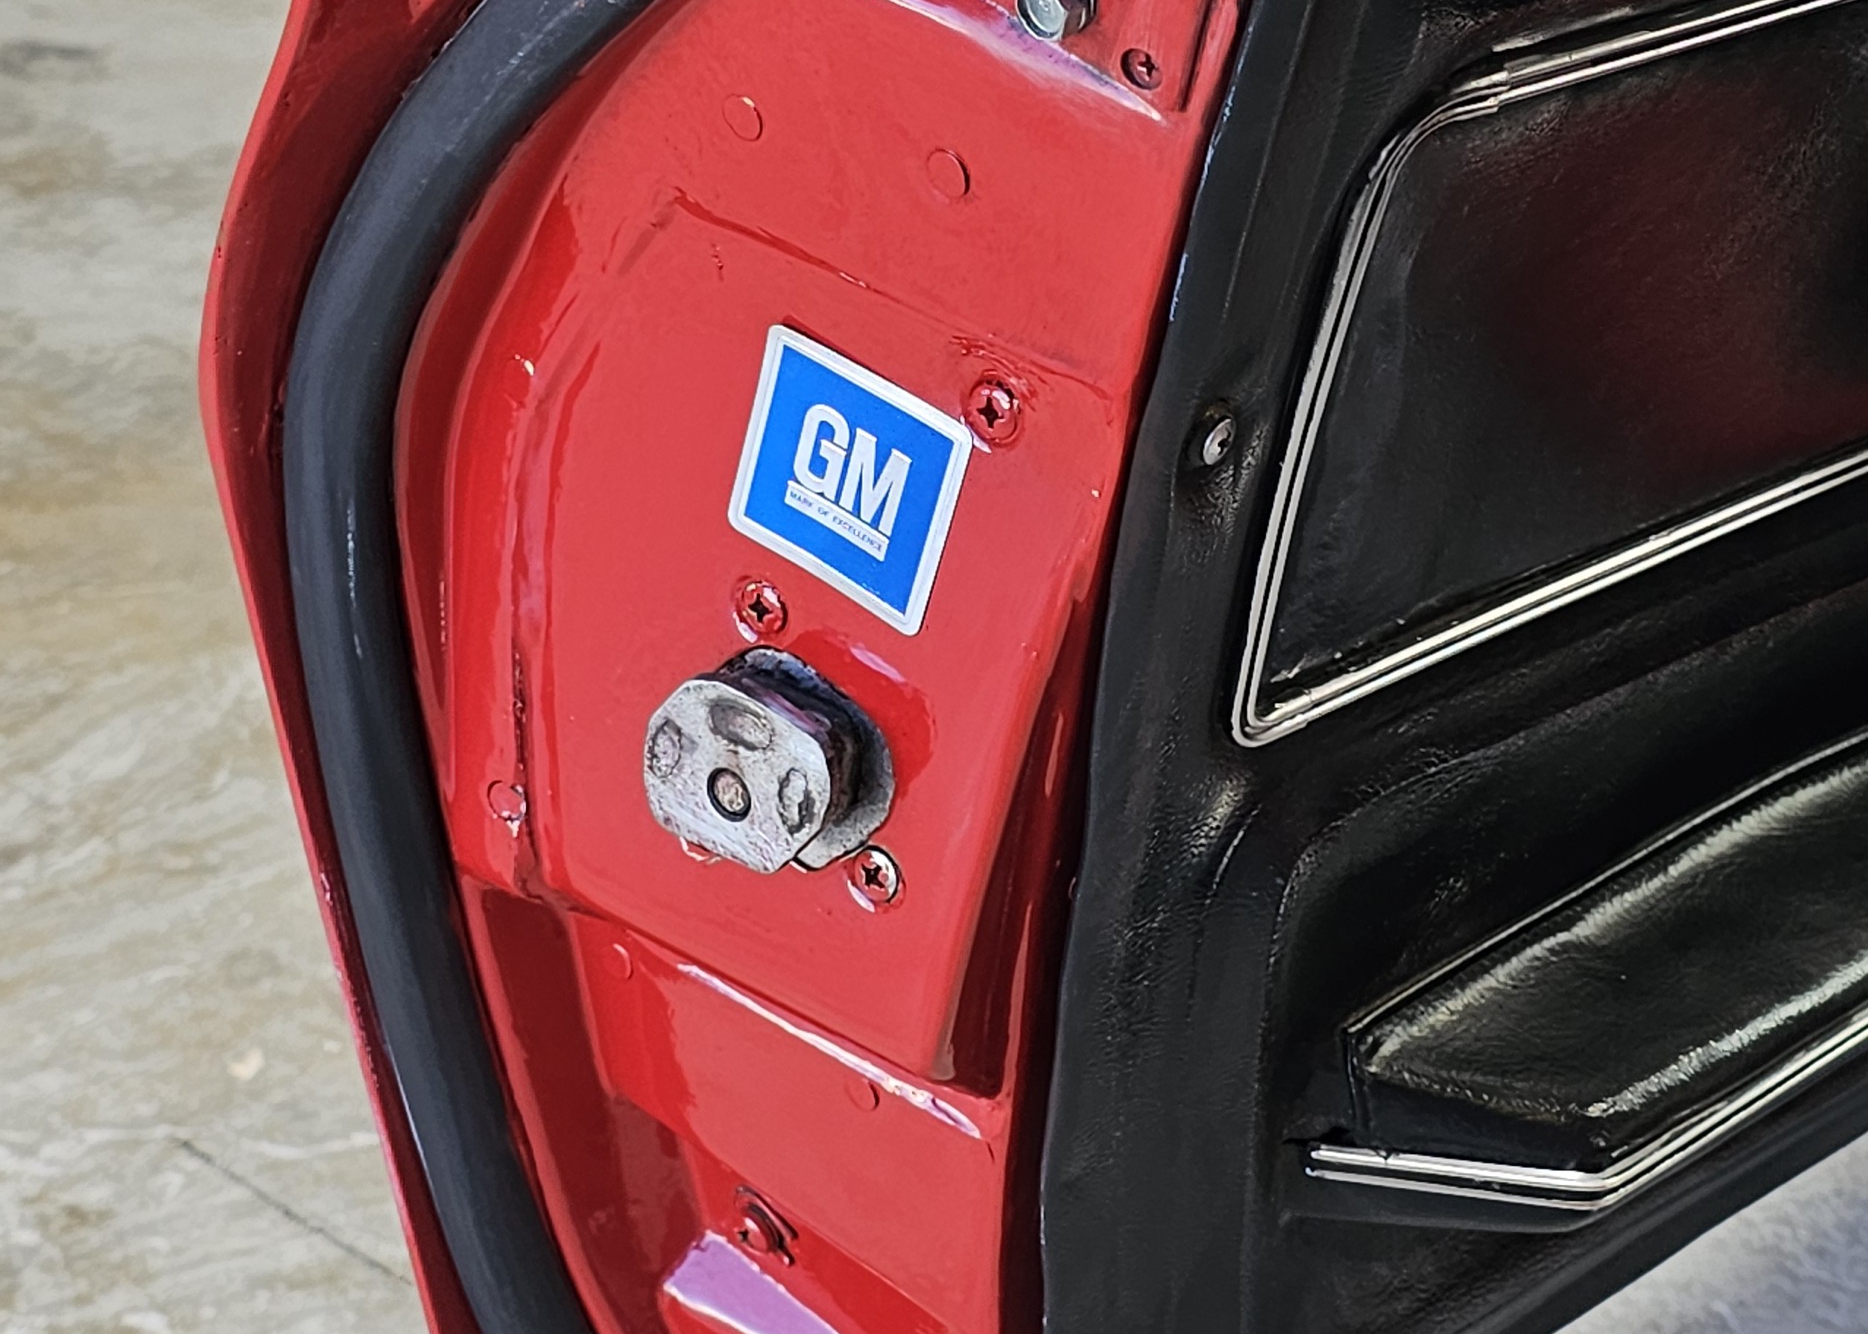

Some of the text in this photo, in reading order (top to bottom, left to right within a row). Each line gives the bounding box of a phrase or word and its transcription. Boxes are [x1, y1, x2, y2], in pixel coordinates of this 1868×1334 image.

[792, 403, 913, 537] GM
[789, 489, 883, 553] MARK OF EXCELLENCE
